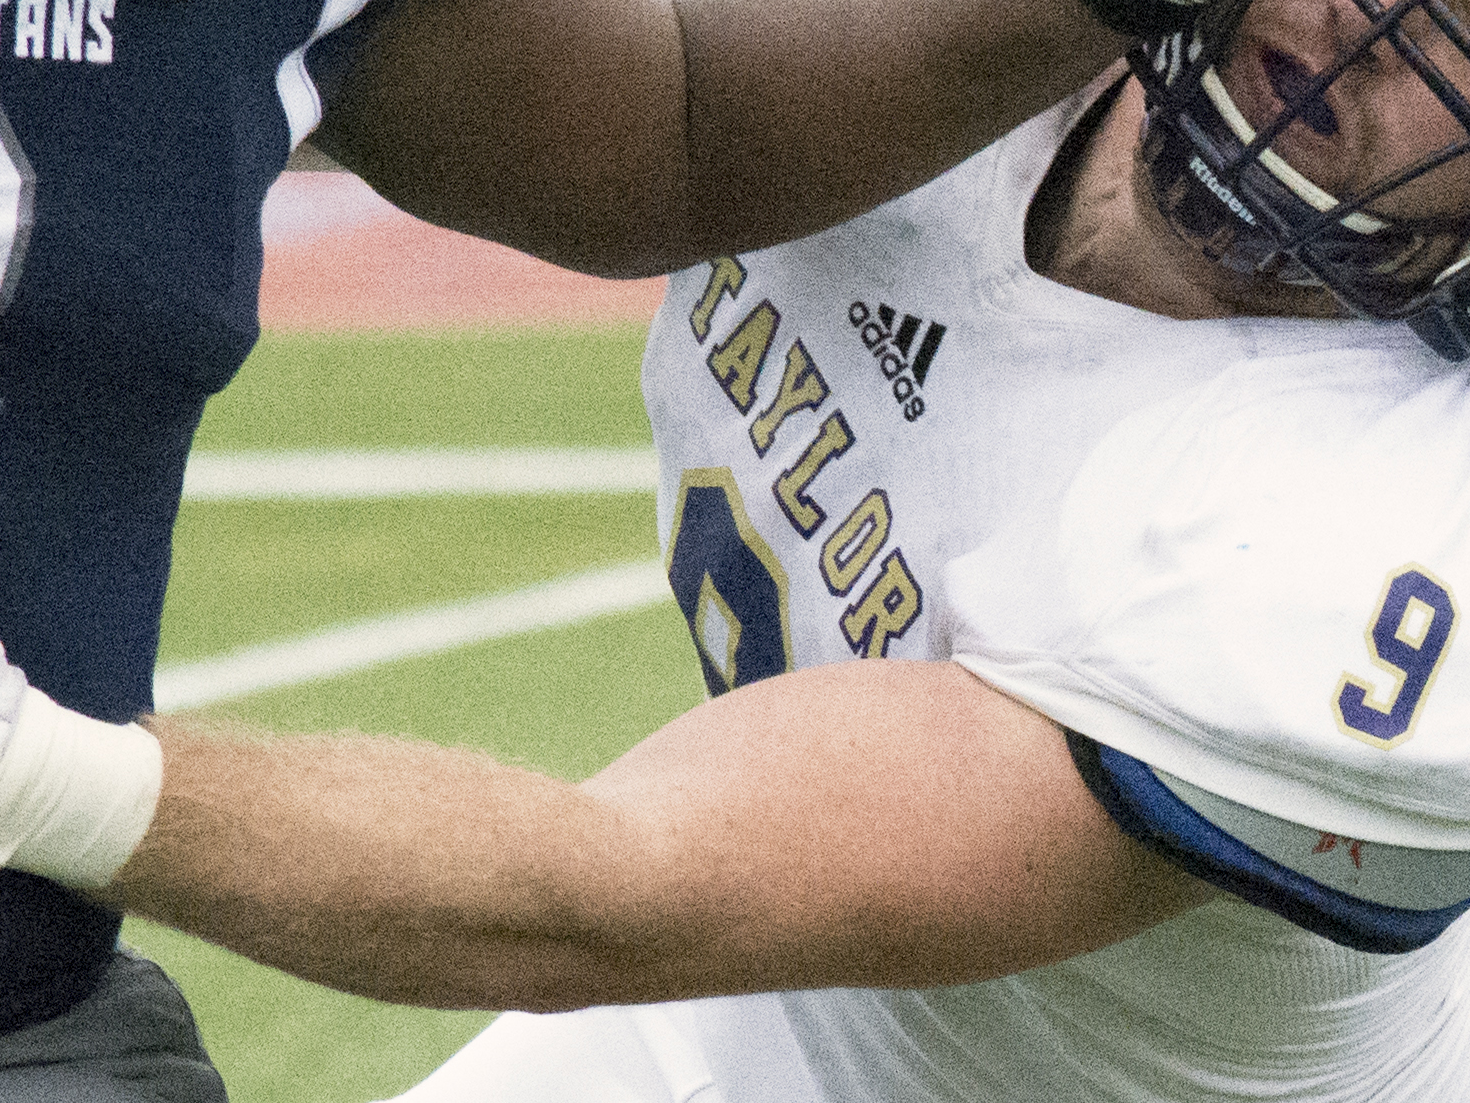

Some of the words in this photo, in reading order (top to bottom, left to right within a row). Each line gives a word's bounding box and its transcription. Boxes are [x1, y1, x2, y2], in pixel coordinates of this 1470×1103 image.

[848, 300, 926, 423] adidas
[689, 256, 924, 660] TAYLOR
[1331, 560, 1461, 752] 9
